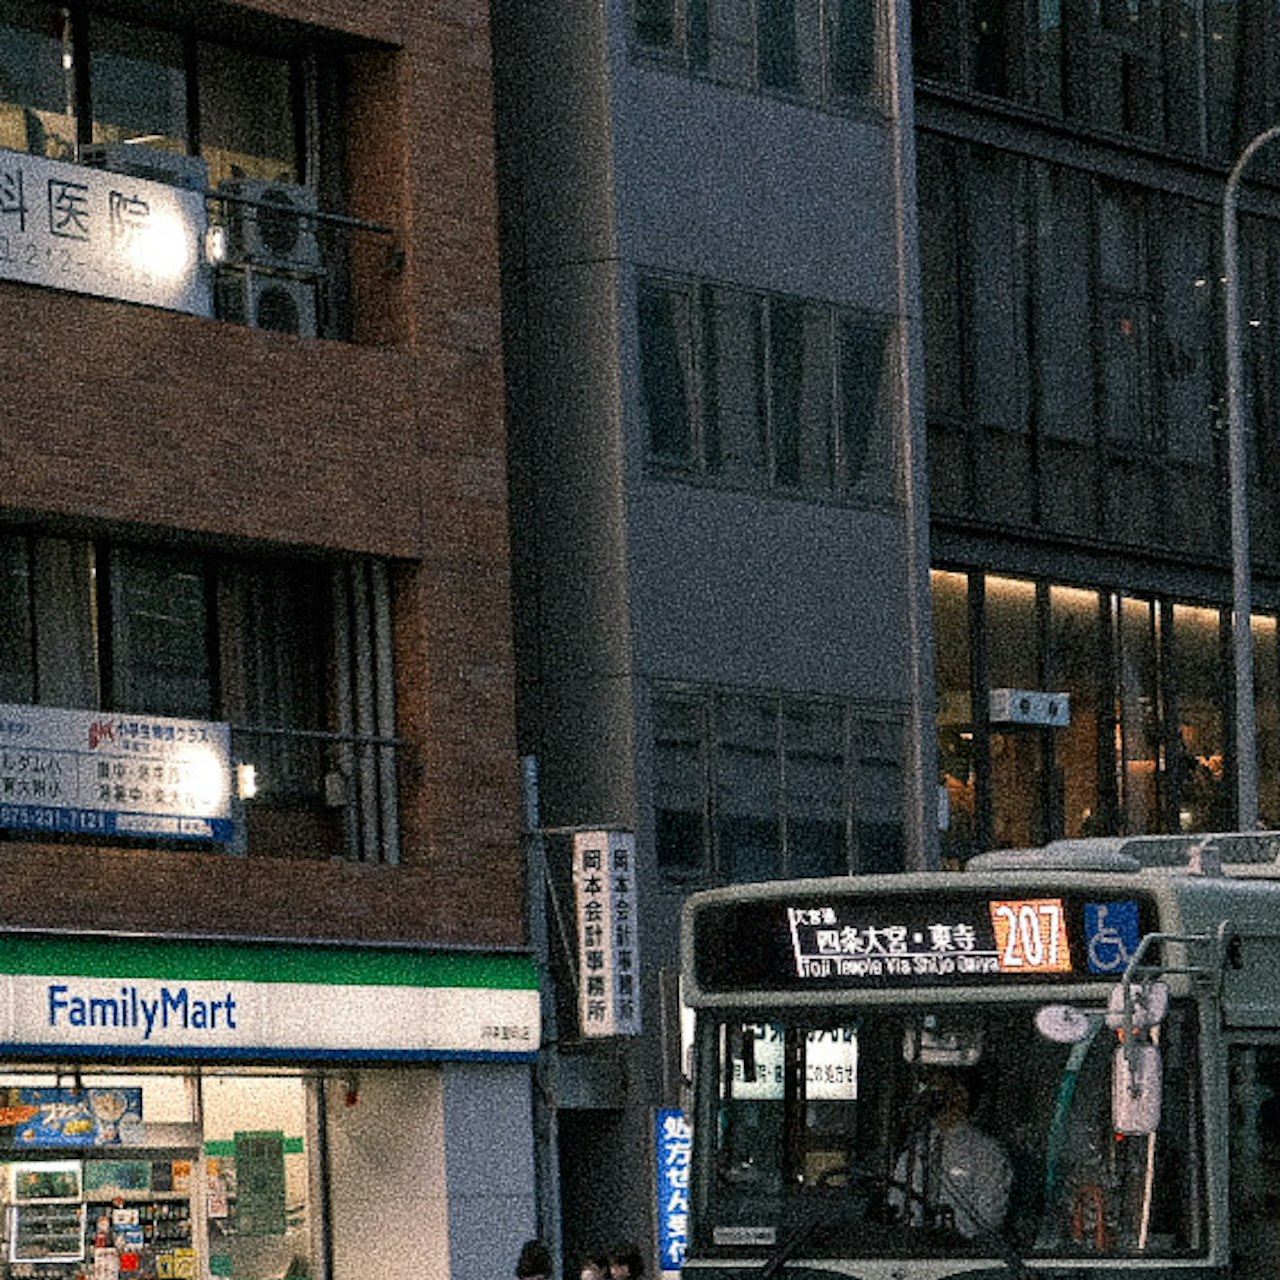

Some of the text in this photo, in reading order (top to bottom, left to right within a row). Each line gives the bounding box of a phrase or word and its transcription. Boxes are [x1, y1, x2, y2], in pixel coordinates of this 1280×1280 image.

[583, 849, 605, 1022] 岡本会計事務所
[816, 923, 977, 954] 四条大宮・東寺
[994, 904, 1060, 968] 207
[47, 985, 237, 1040] FamilyMart
